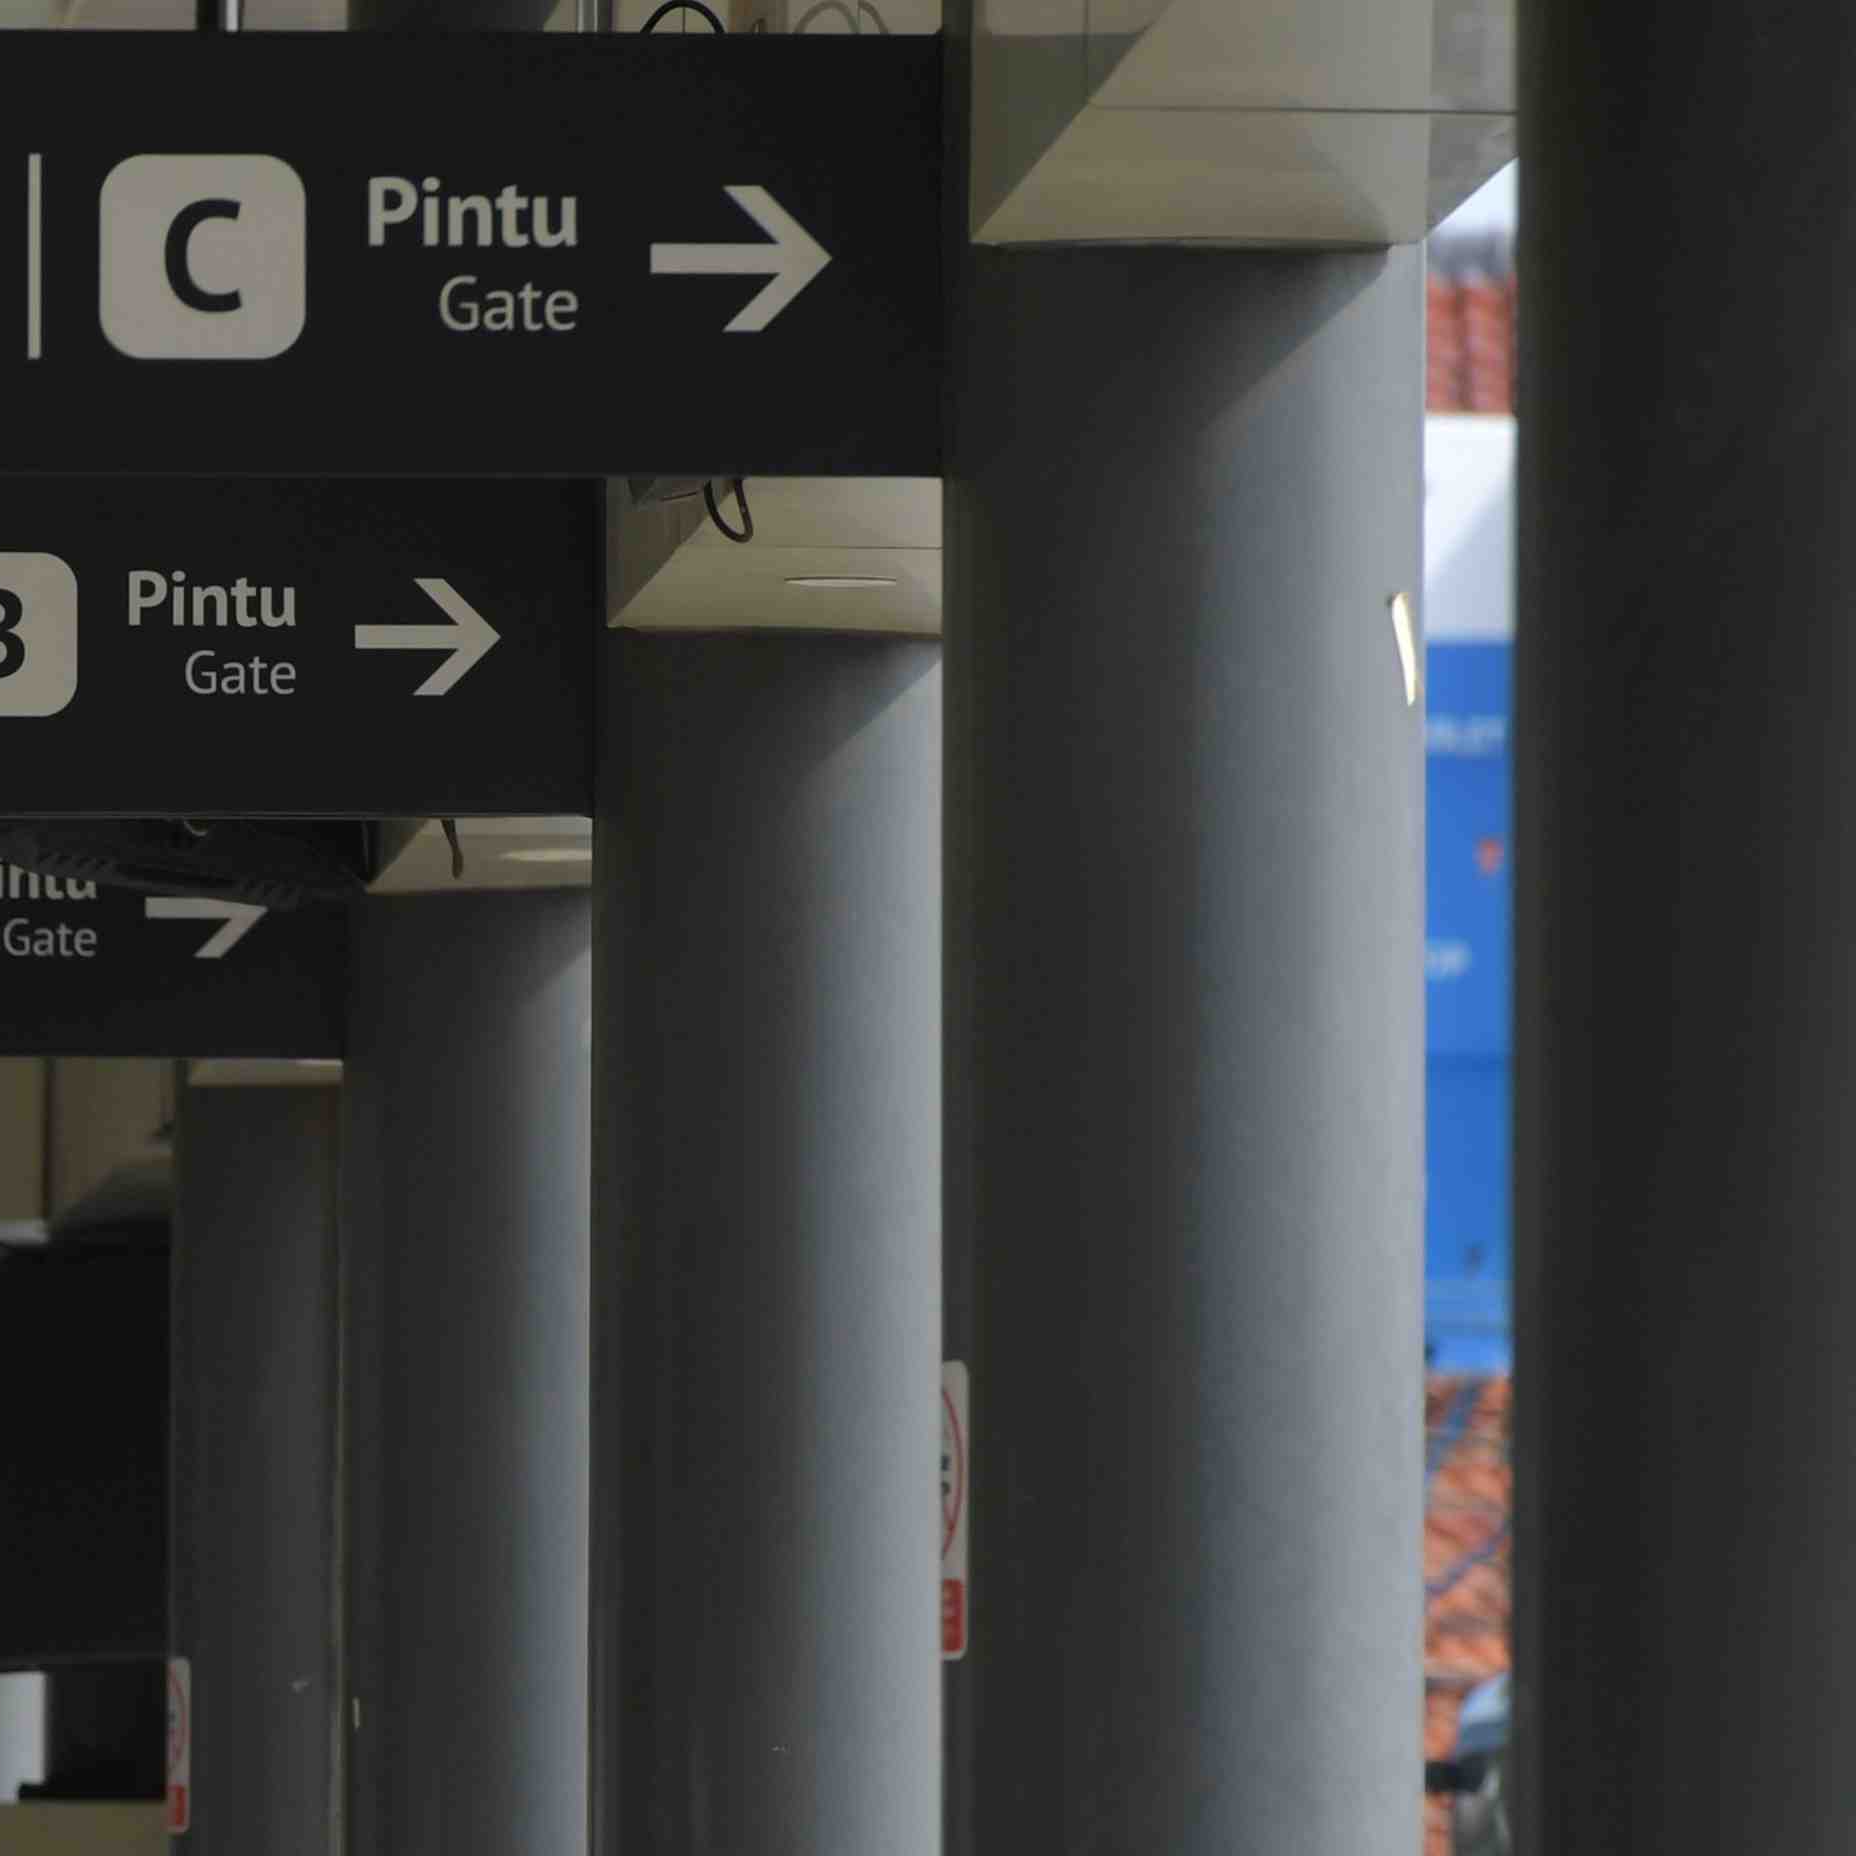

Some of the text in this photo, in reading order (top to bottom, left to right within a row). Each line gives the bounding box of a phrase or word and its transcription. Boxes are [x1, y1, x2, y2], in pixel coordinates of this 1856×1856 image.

[369, 176, 580, 249] Pintu
[164, 198, 245, 316] C
[439, 276, 581, 334] Gate
[128, 570, 298, 630] Pintu
[184, 649, 299, 697] Gate
[3, 917, 99, 960] Gate
